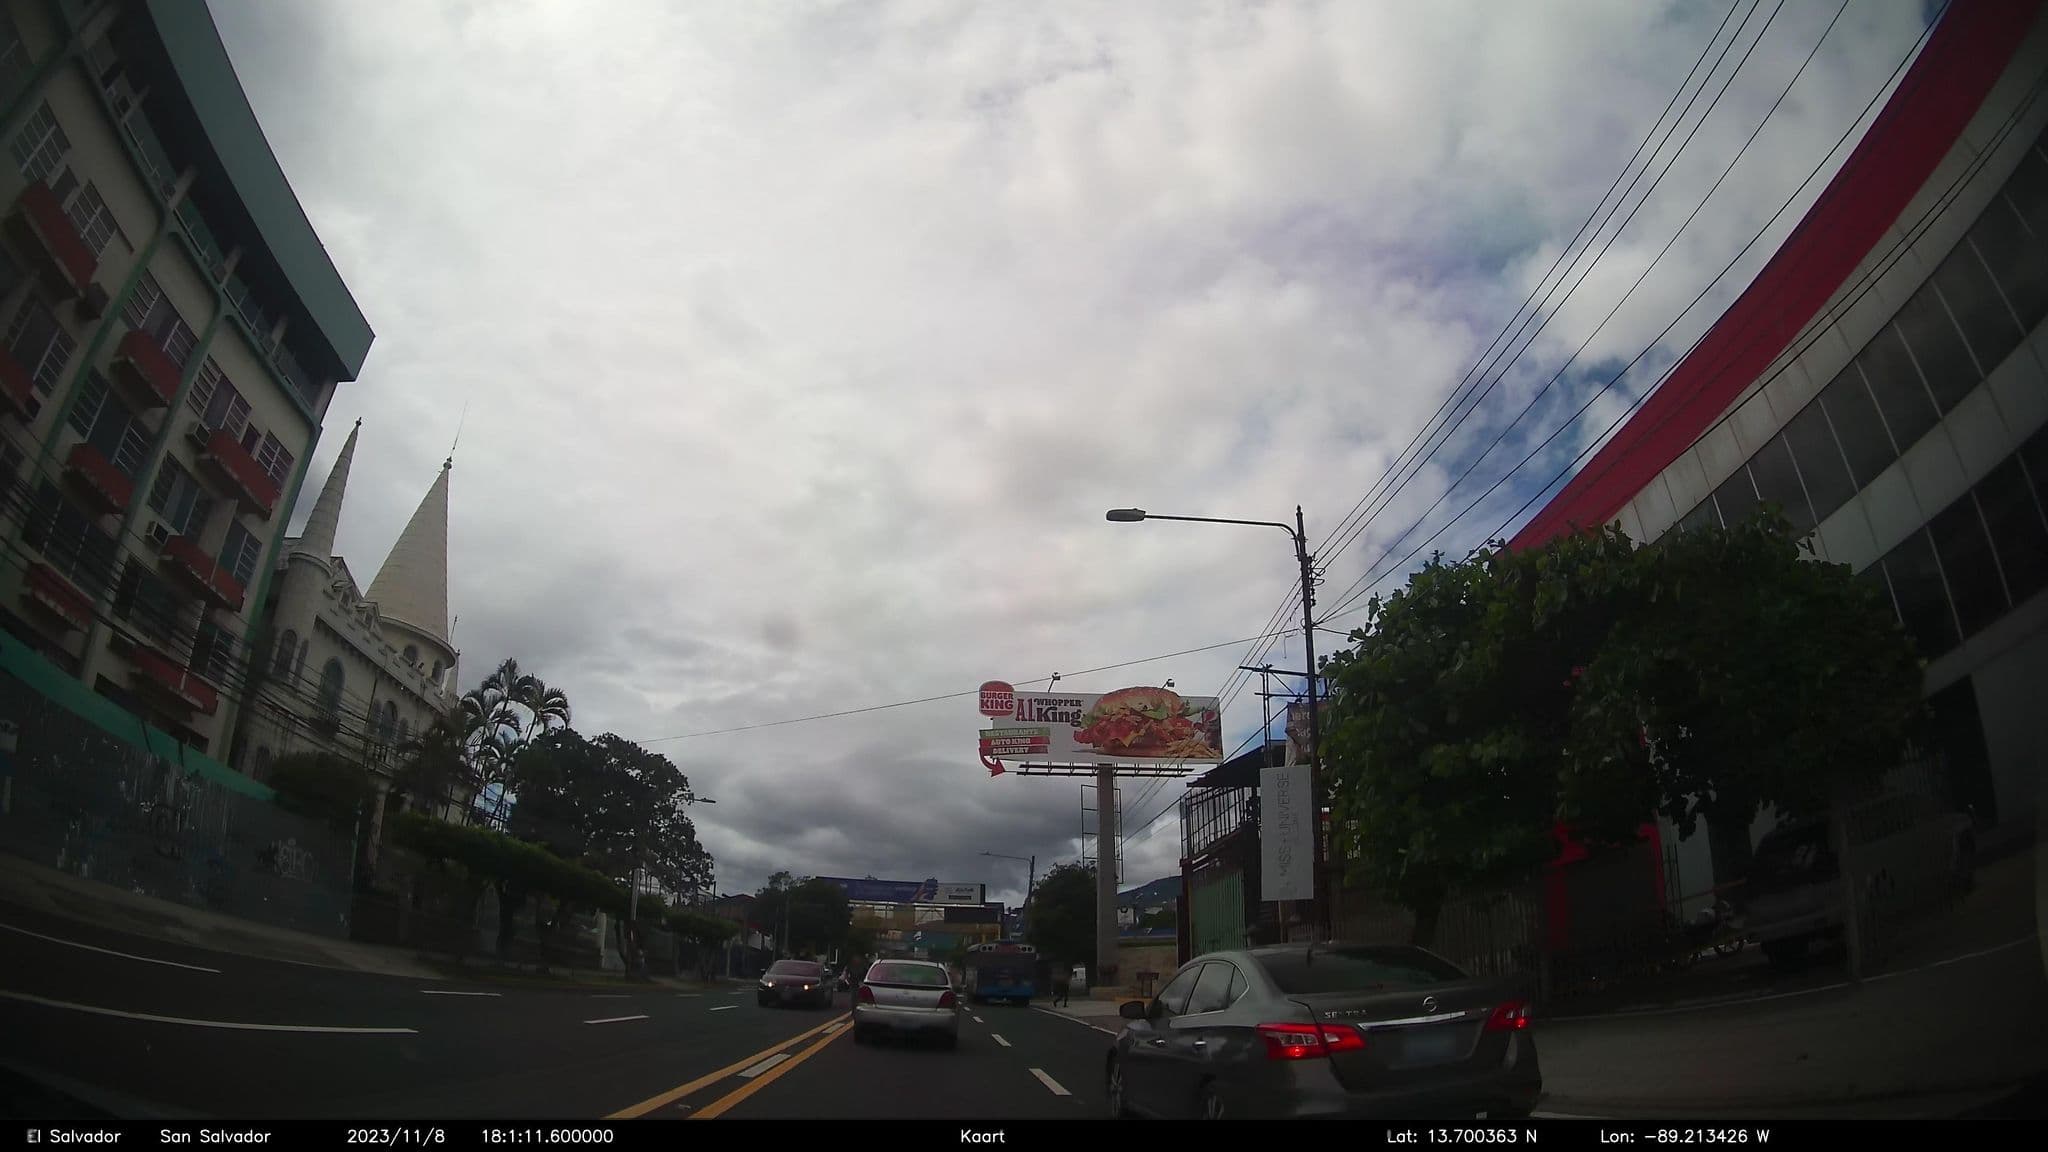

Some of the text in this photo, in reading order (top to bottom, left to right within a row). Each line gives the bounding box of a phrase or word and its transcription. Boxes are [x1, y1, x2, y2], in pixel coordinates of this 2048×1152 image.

[980, 700, 1013, 710] KING
[1033, 698, 1082, 706] WHOPPER
[1036, 707, 1082, 727] King
[990, 737, 1031, 746] AUTO KING
[992, 746, 1030, 755] DELIVERY
[1276, 772, 1292, 877] MISS UNIVERSE
[1324, 1009, 1368, 1019] SETRA
